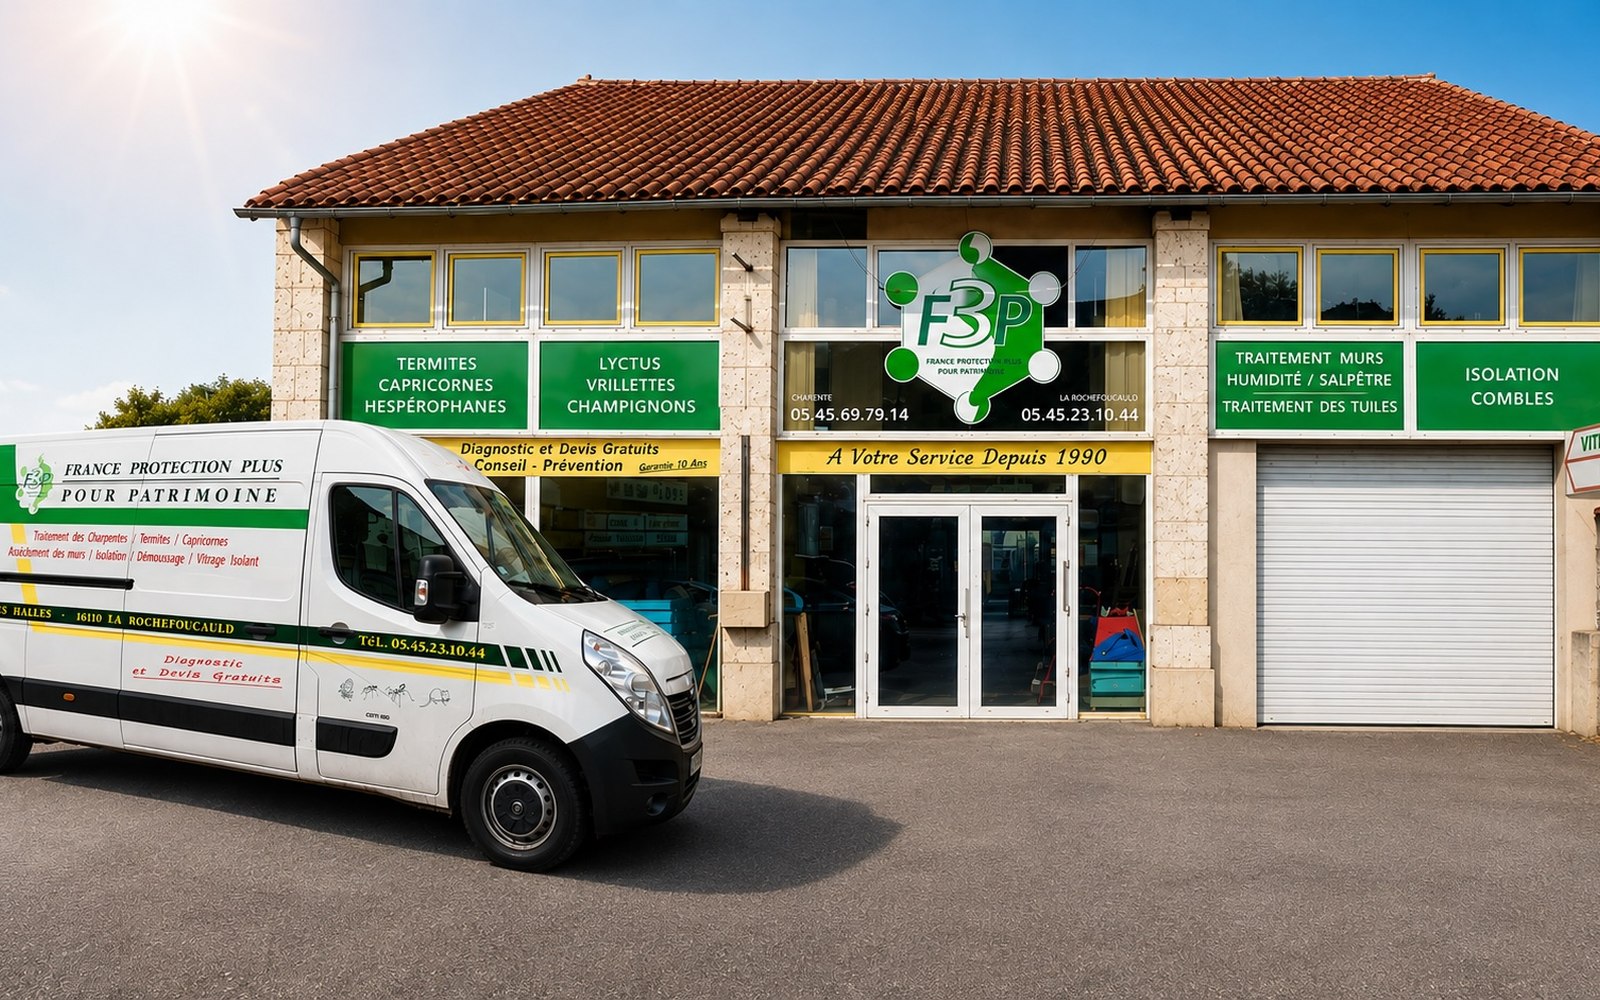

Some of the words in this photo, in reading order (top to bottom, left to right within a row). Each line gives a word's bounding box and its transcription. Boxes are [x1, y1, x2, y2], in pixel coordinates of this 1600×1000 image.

[917, 277, 1033, 348] F3P
[397, 357, 477, 371] TERMITES
[599, 357, 661, 371] LYCTUS
[1235, 351, 1332, 365] TRAITEMENT
[1340, 351, 1384, 365] MURS
[1227, 370, 1302, 387] HUMIDITÉ
[1319, 370, 1392, 387] SALPÊTRE
[1465, 367, 1559, 382] ISOLATION
[378, 378, 494, 392] CAPRICORNES
[586, 378, 676, 392] VRILLETTES
[791, 393, 832, 401] CHARENTE
[1060, 394, 1070, 402] LA
[1071, 394, 1138, 402] ROCHEFOUCAULD
[1471, 391, 1554, 406] COMBLES
[365, 396, 507, 414] HESPÉROPHANES
[567, 399, 696, 414] CHAMPIGNONS
[1222, 400, 1313, 414] TRAITEMENT
[1320, 400, 1346, 414] DES
[1351, 400, 1398, 414] TUILES
[790, 407, 909, 421] 05.45.69.79.14
[1021, 407, 1139, 421] 05.45.23.10.44
[461, 442, 534, 458] Diagnostic
[540, 443, 553, 455] et
[559, 443, 597, 455] Devis
[603, 442, 659, 455] Gratuits
[1581, 433, 1600, 452] VIT
[474, 459, 526, 472] Conseil
[543, 459, 623, 472] Prévention
[678, 459, 688, 469] 10
[690, 459, 708, 468] Ans
[826, 448, 842, 465] A
[851, 448, 899, 465] Votre
[907, 448, 974, 465] Service
[982, 448, 1047, 470] Depuis
[1056, 448, 1107, 466] 1990
[64, 463, 121, 476] FRANCE
[129, 460, 232, 475] PROTECTION
[240, 459, 283, 473] PLUS
[62, 488, 115, 503] POUR
[128, 488, 277, 503] PATRIMOINE
[34, 530, 69, 542] Traitement
[72, 531, 84, 542] des
[88, 531, 128, 545] Charpentes
[140, 533, 170, 545] Termites
[182, 534, 228, 548] Capricornes
[52, 548, 65, 558] des
[67, 550, 85, 560] murs
[96, 549, 127, 560] Isolation
[196, 553, 226, 568] Vitrage
[230, 554, 259, 567] Isolant
[13, 607, 52, 618] HALLES
[76, 612, 102, 623] 16110
[108, 614, 122, 625] LA
[128, 616, 235, 634] ROCHEFOUCAULD
[391, 638, 486, 659] 05.45.23.10.44
[164, 655, 244, 669] Diagnostic
[132, 668, 147, 676] et
[159, 668, 201, 679] Devis
[213, 671, 282, 684] Gratuits
